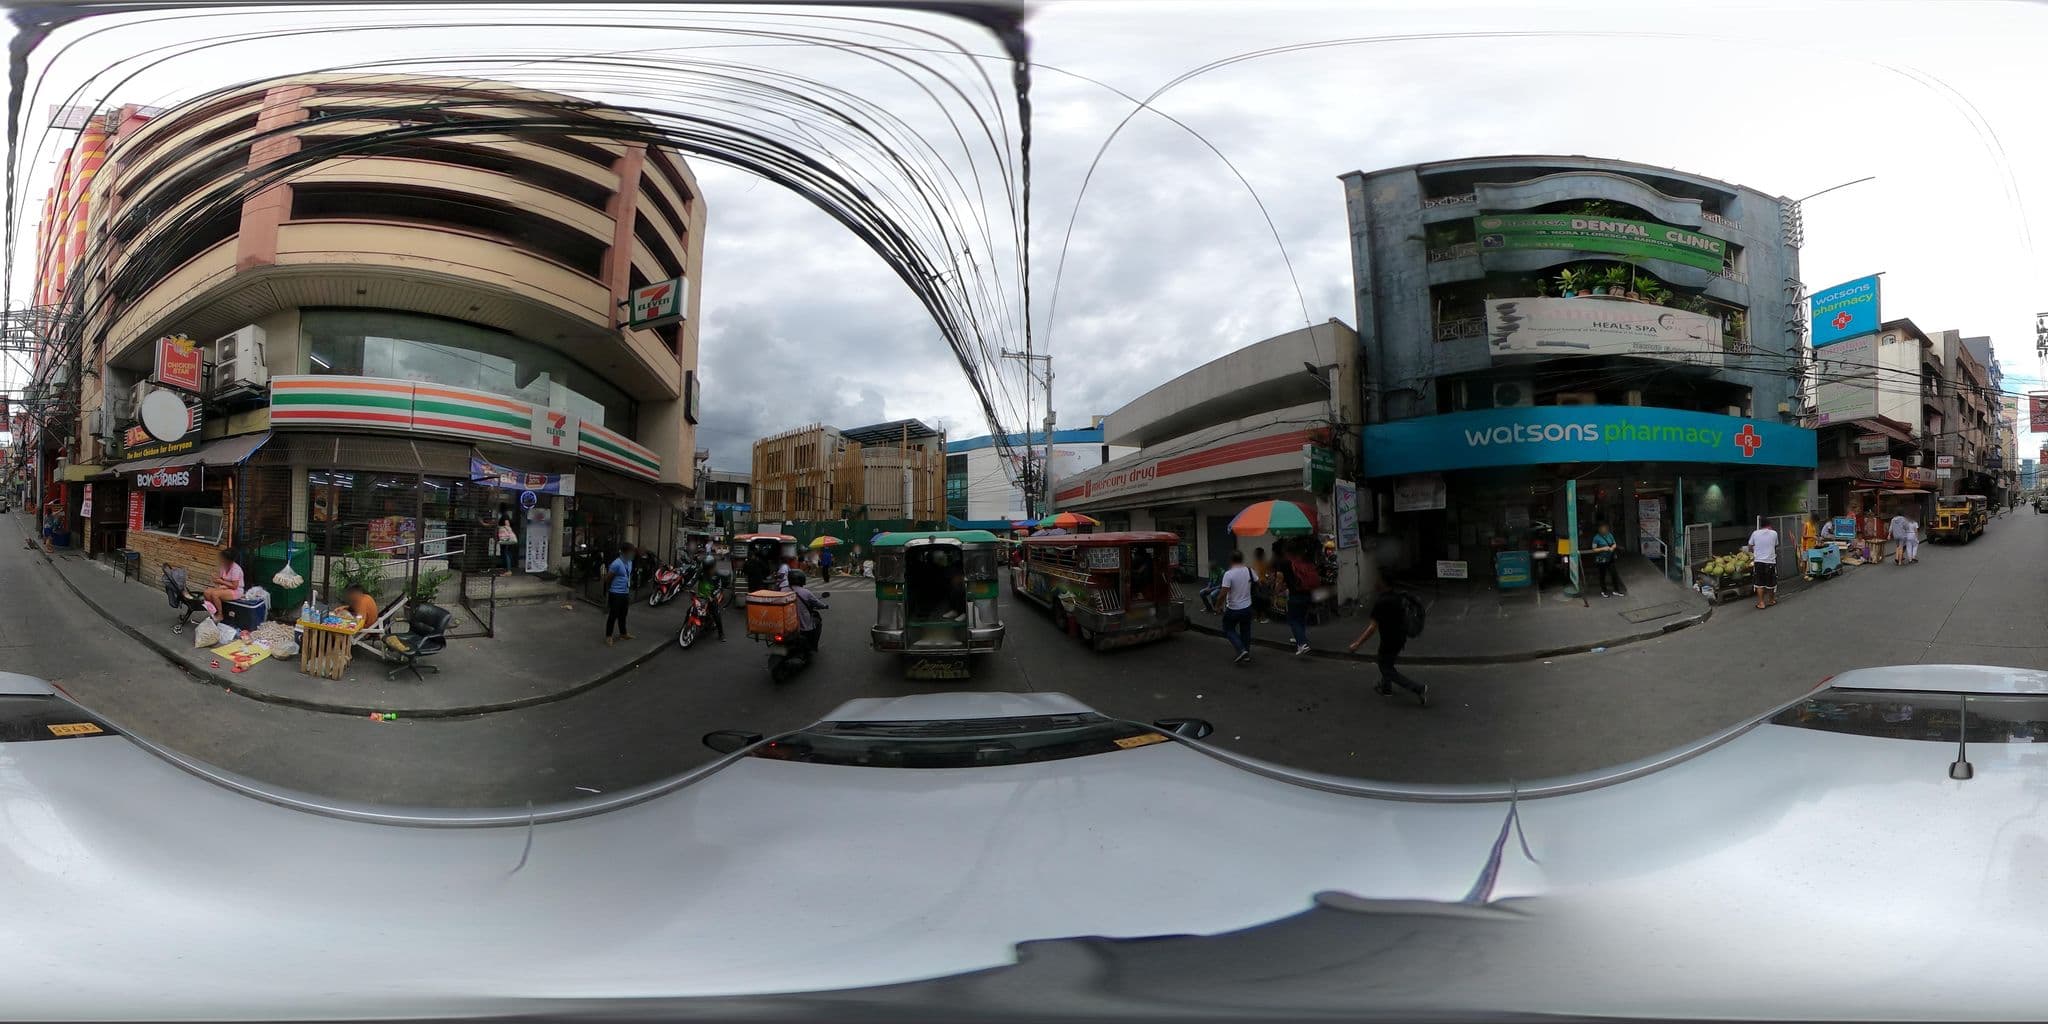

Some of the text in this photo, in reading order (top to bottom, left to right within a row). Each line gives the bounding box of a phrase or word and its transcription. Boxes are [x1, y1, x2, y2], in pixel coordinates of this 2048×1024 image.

[1571, 219, 1649, 237] DENTAL
[1666, 231, 1720, 252] CLINIC
[640, 284, 670, 319] 7
[1813, 293, 1873, 317] pharmacy
[1816, 283, 1870, 305] watsons
[1592, 321, 1632, 331] HEALS
[1636, 325, 1657, 333] SPA
[1465, 419, 1723, 447] watsons pharmacy
[162, 471, 190, 487] PARES
[1092, 473, 1127, 491] mercury
[1129, 466, 1155, 482] drug
